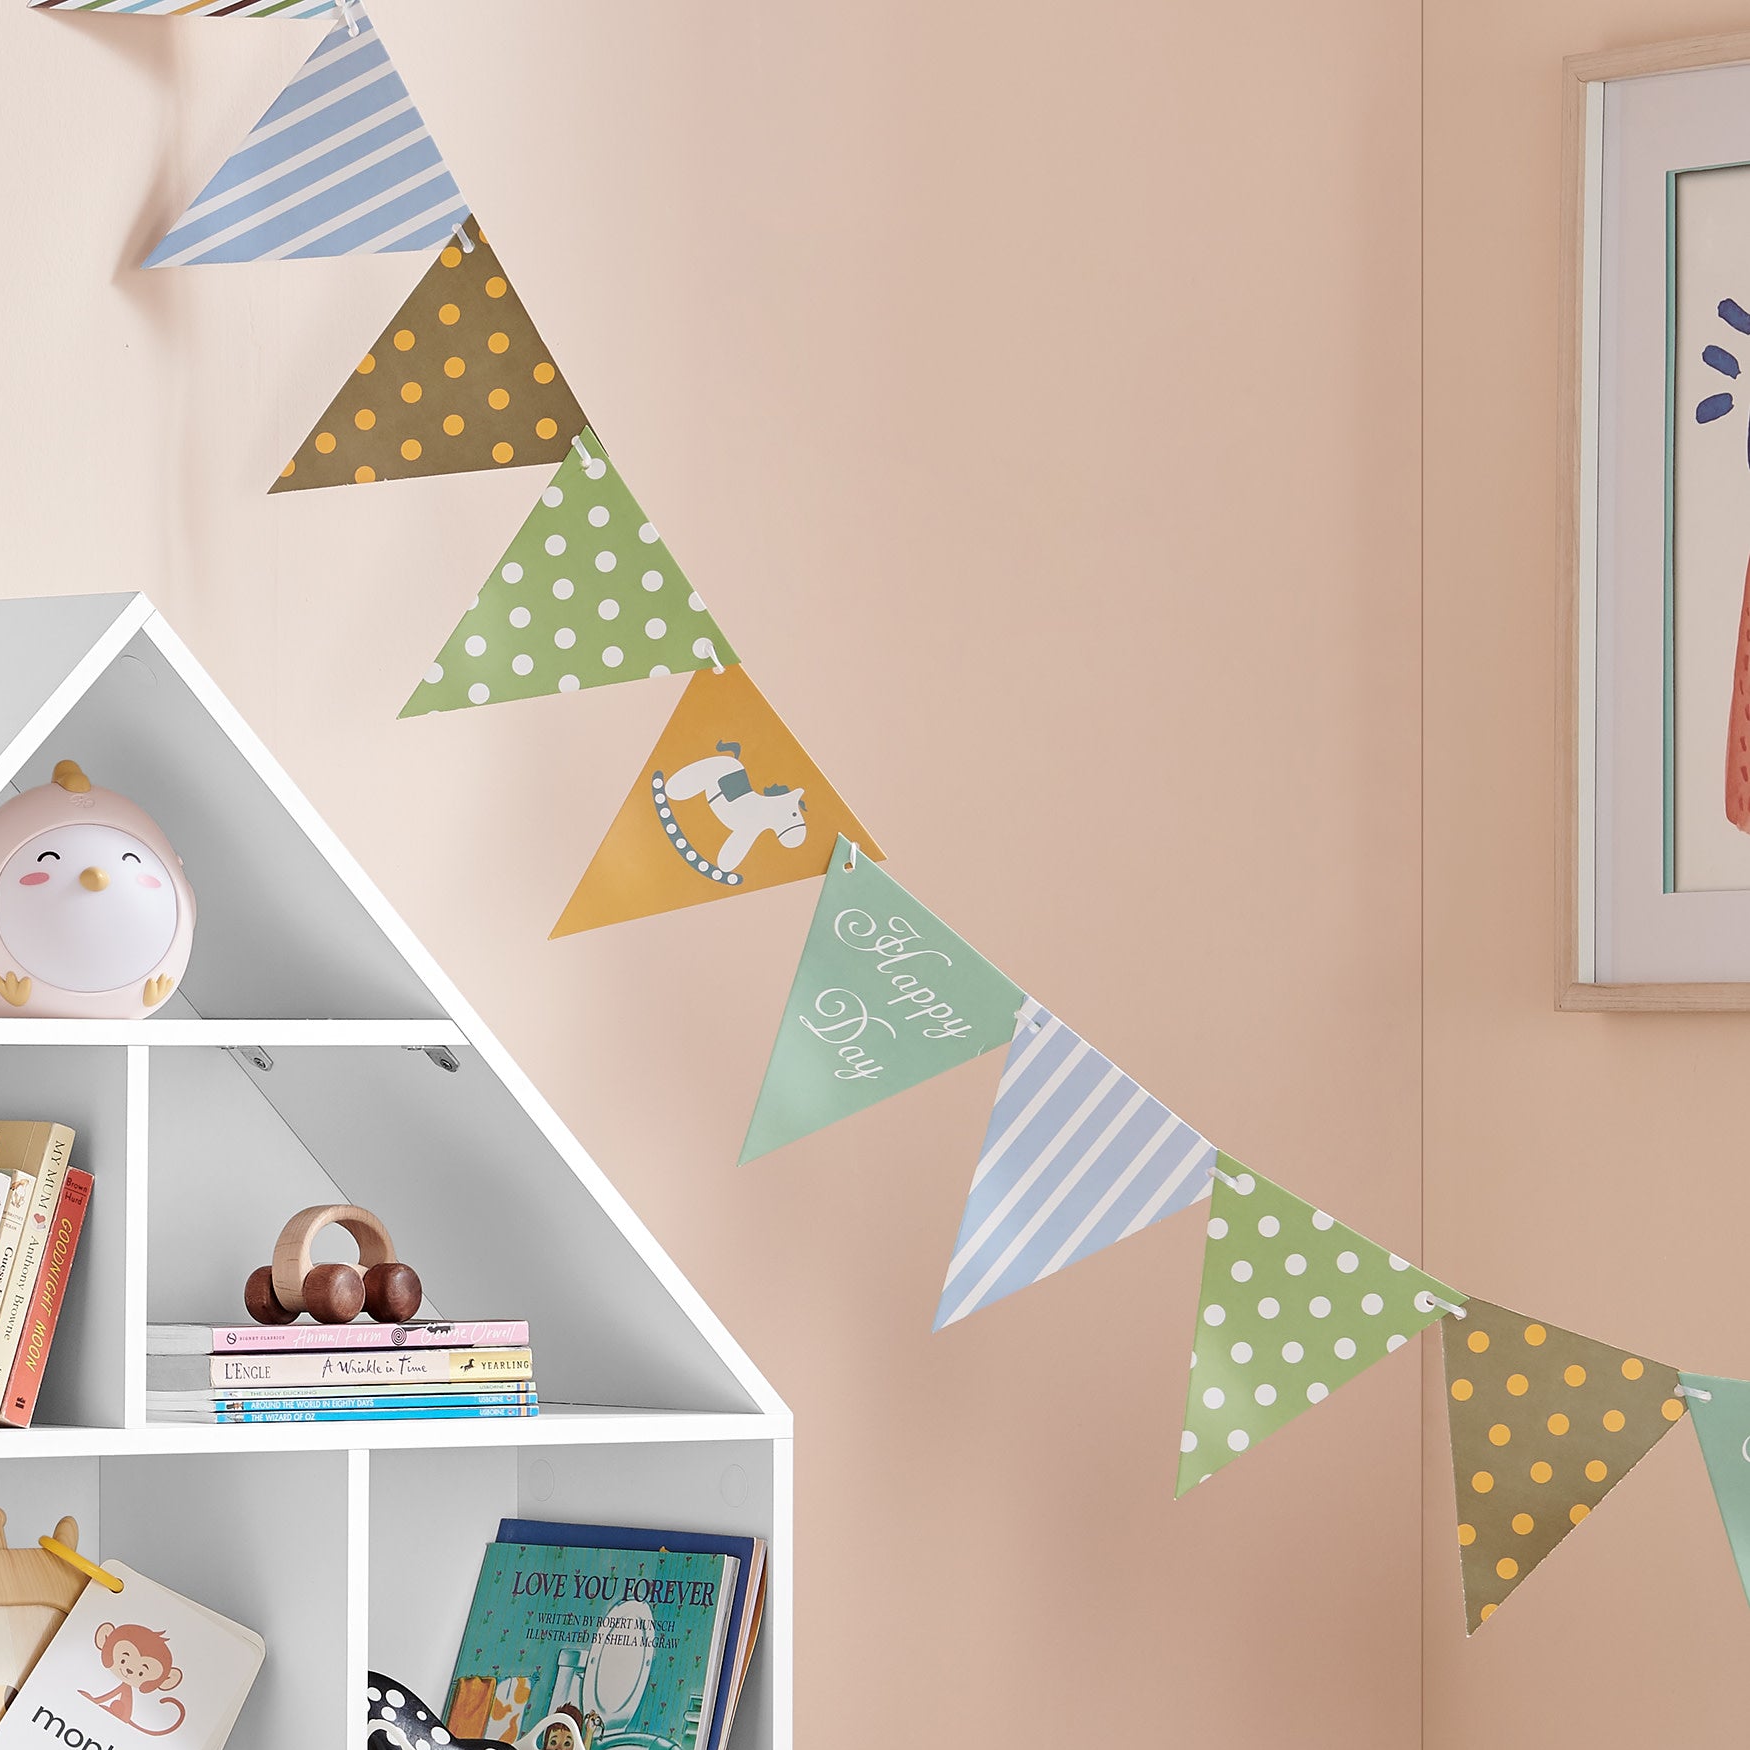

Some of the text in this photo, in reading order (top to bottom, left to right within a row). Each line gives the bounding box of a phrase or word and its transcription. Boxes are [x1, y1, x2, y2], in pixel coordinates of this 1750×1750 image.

[834, 908, 972, 1039] Happy
[799, 988, 897, 1080] Day
[38, 1140, 66, 1209] MY MUM
[66, 1177, 88, 1193] Brown
[65, 1191, 84, 1206] Hurd
[4, 1236, 40, 1341] Anthony Browne
[25, 1218, 73, 1373] GOODNIGHT MOON
[292, 1327, 341, 1348] Animal
[343, 1328, 382, 1347] Farm
[420, 1322, 468, 1345] George
[470, 1322, 516, 1343] Orwell
[321, 1356, 333, 1378] A
[336, 1360, 382, 1376] Wrinkle
[384, 1361, 396, 1374] in
[397, 1355, 428, 1376] Time
[480, 1360, 530, 1371] YEARLING
[250, 1400, 281, 1410] AROUND
[282, 1400, 296, 1409] THE
[295, 1400, 323, 1409] WORLD
[323, 1399, 331, 1409] IN
[331, 1399, 356, 1408] EIGHTY
[356, 1399, 375, 1408] DAYS
[281, 1389, 318, 1397] DUCKLING
[250, 1413, 265, 1422] THE
[265, 1412, 292, 1422] WIZARD
[293, 1412, 304, 1421] OF
[305, 1412, 316, 1421] OZ
[512, 1571, 715, 1606] LOVE YOU FOREVER
[537, 1612, 675, 1633] WRITTEN BY ROBERT MUNSCH
[525, 1629, 680, 1649] ILLUSTRATED BY SHEILA McGRAW
